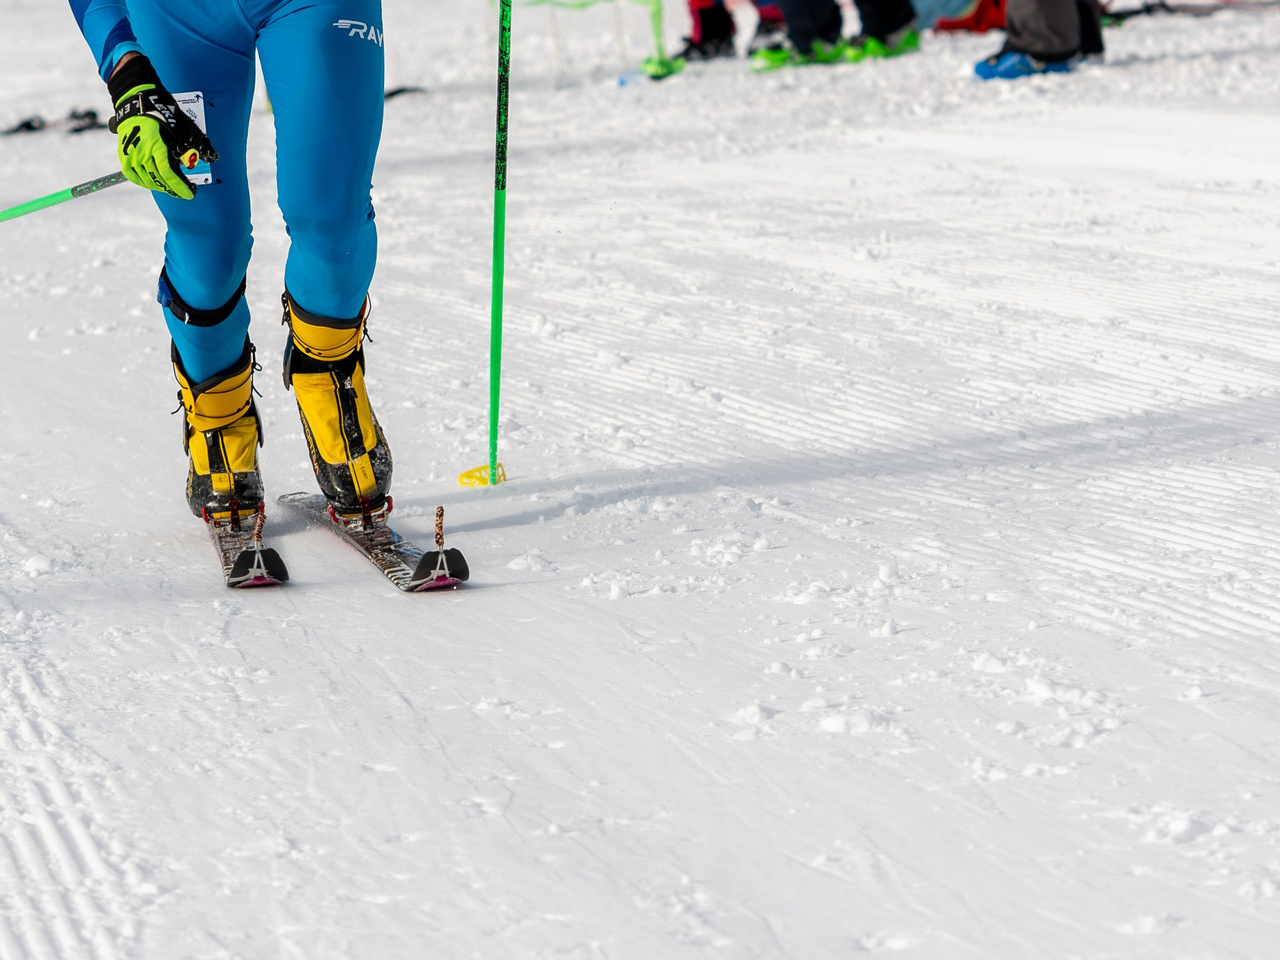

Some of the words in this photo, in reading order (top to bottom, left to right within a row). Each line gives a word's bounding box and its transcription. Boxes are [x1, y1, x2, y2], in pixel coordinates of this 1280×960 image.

[117, 100, 140, 122] LEKI
[148, 95, 177, 125] LEKI
[185, 107, 198, 120] 2024
